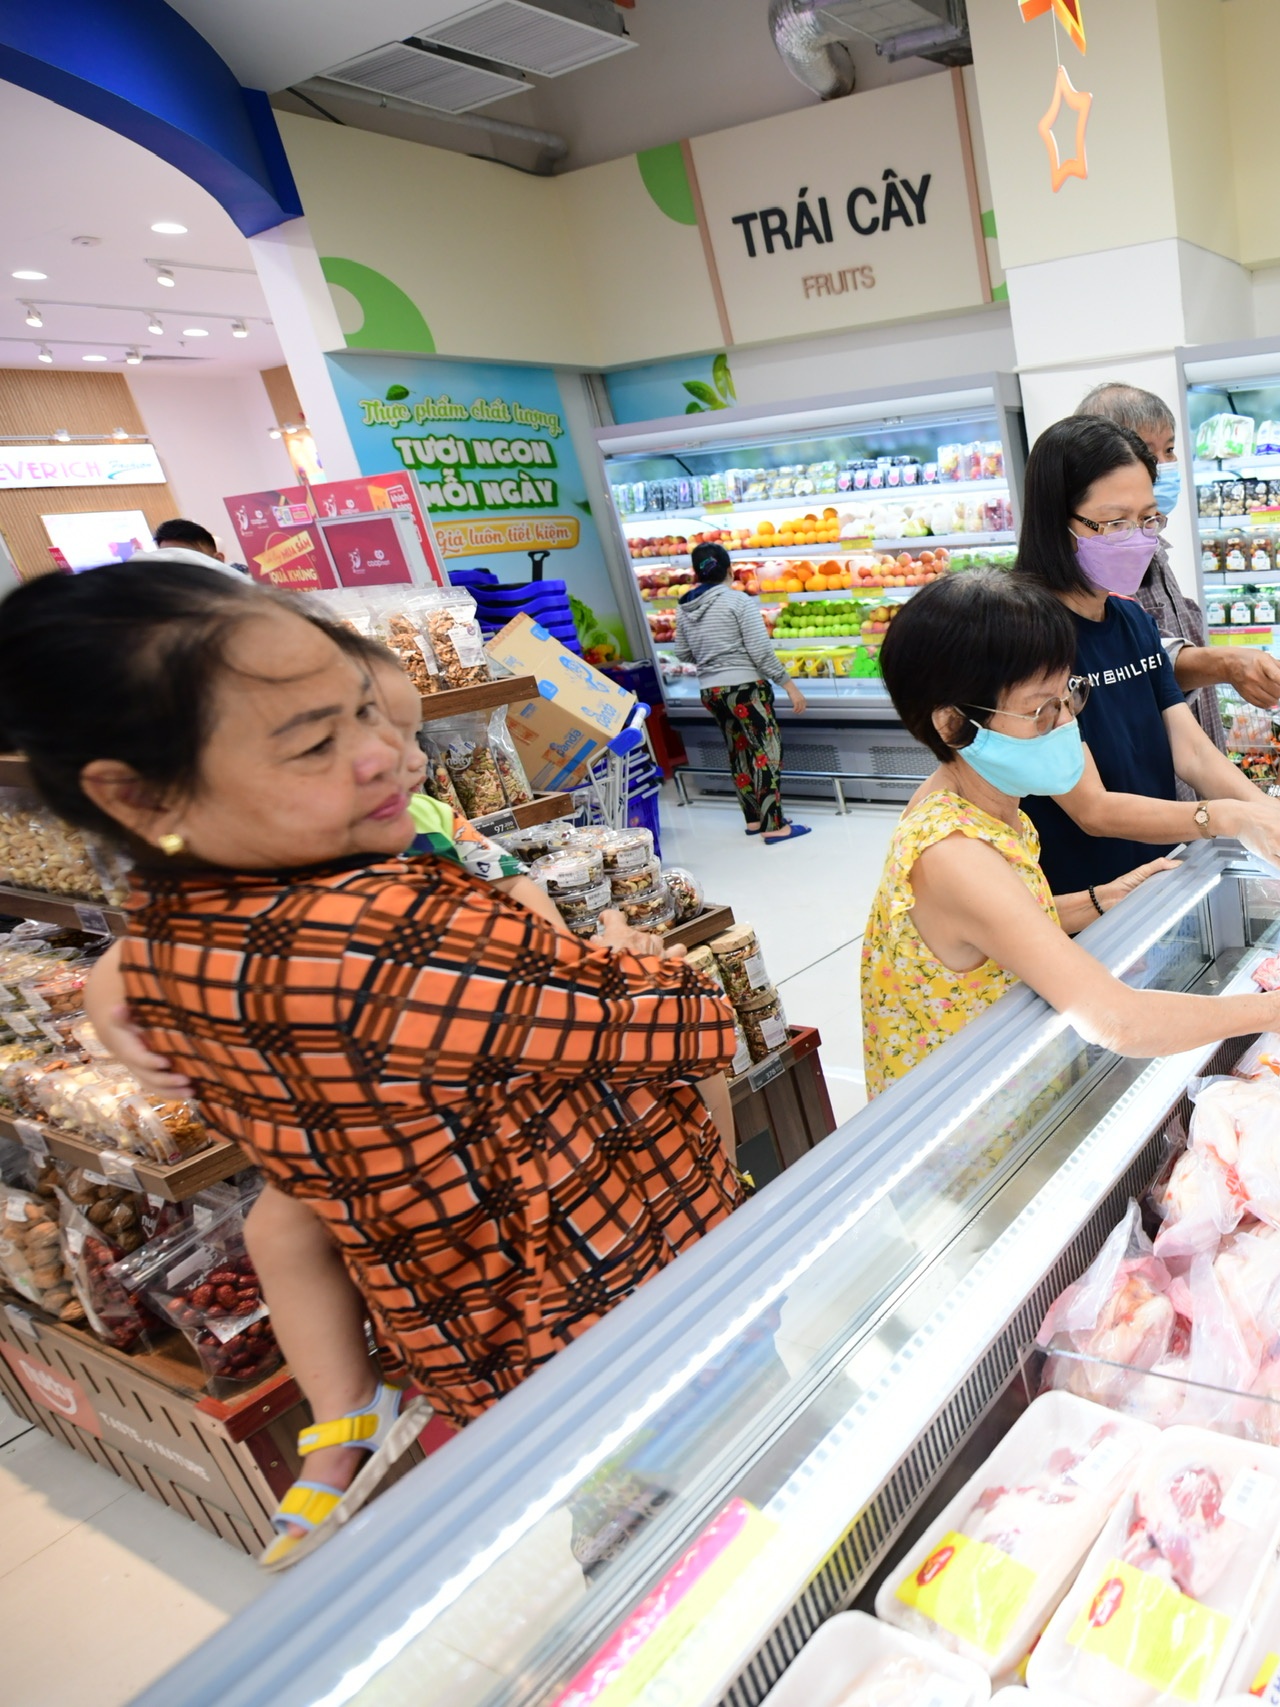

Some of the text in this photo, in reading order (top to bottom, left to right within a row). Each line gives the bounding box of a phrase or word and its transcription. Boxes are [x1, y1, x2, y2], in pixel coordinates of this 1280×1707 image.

[731, 168, 931, 257] TRÁI CÂY
[801, 265, 876, 299] FRUITS
[360, 395, 563, 436] Thực phẩm chất lượng
[394, 436, 553, 464] TƯƠI NGON
[420, 469, 554, 507] MỖI NGÀY
[435, 521, 571, 554] Giá luôn tiết kiệm
[555, 729, 582, 757] panda
